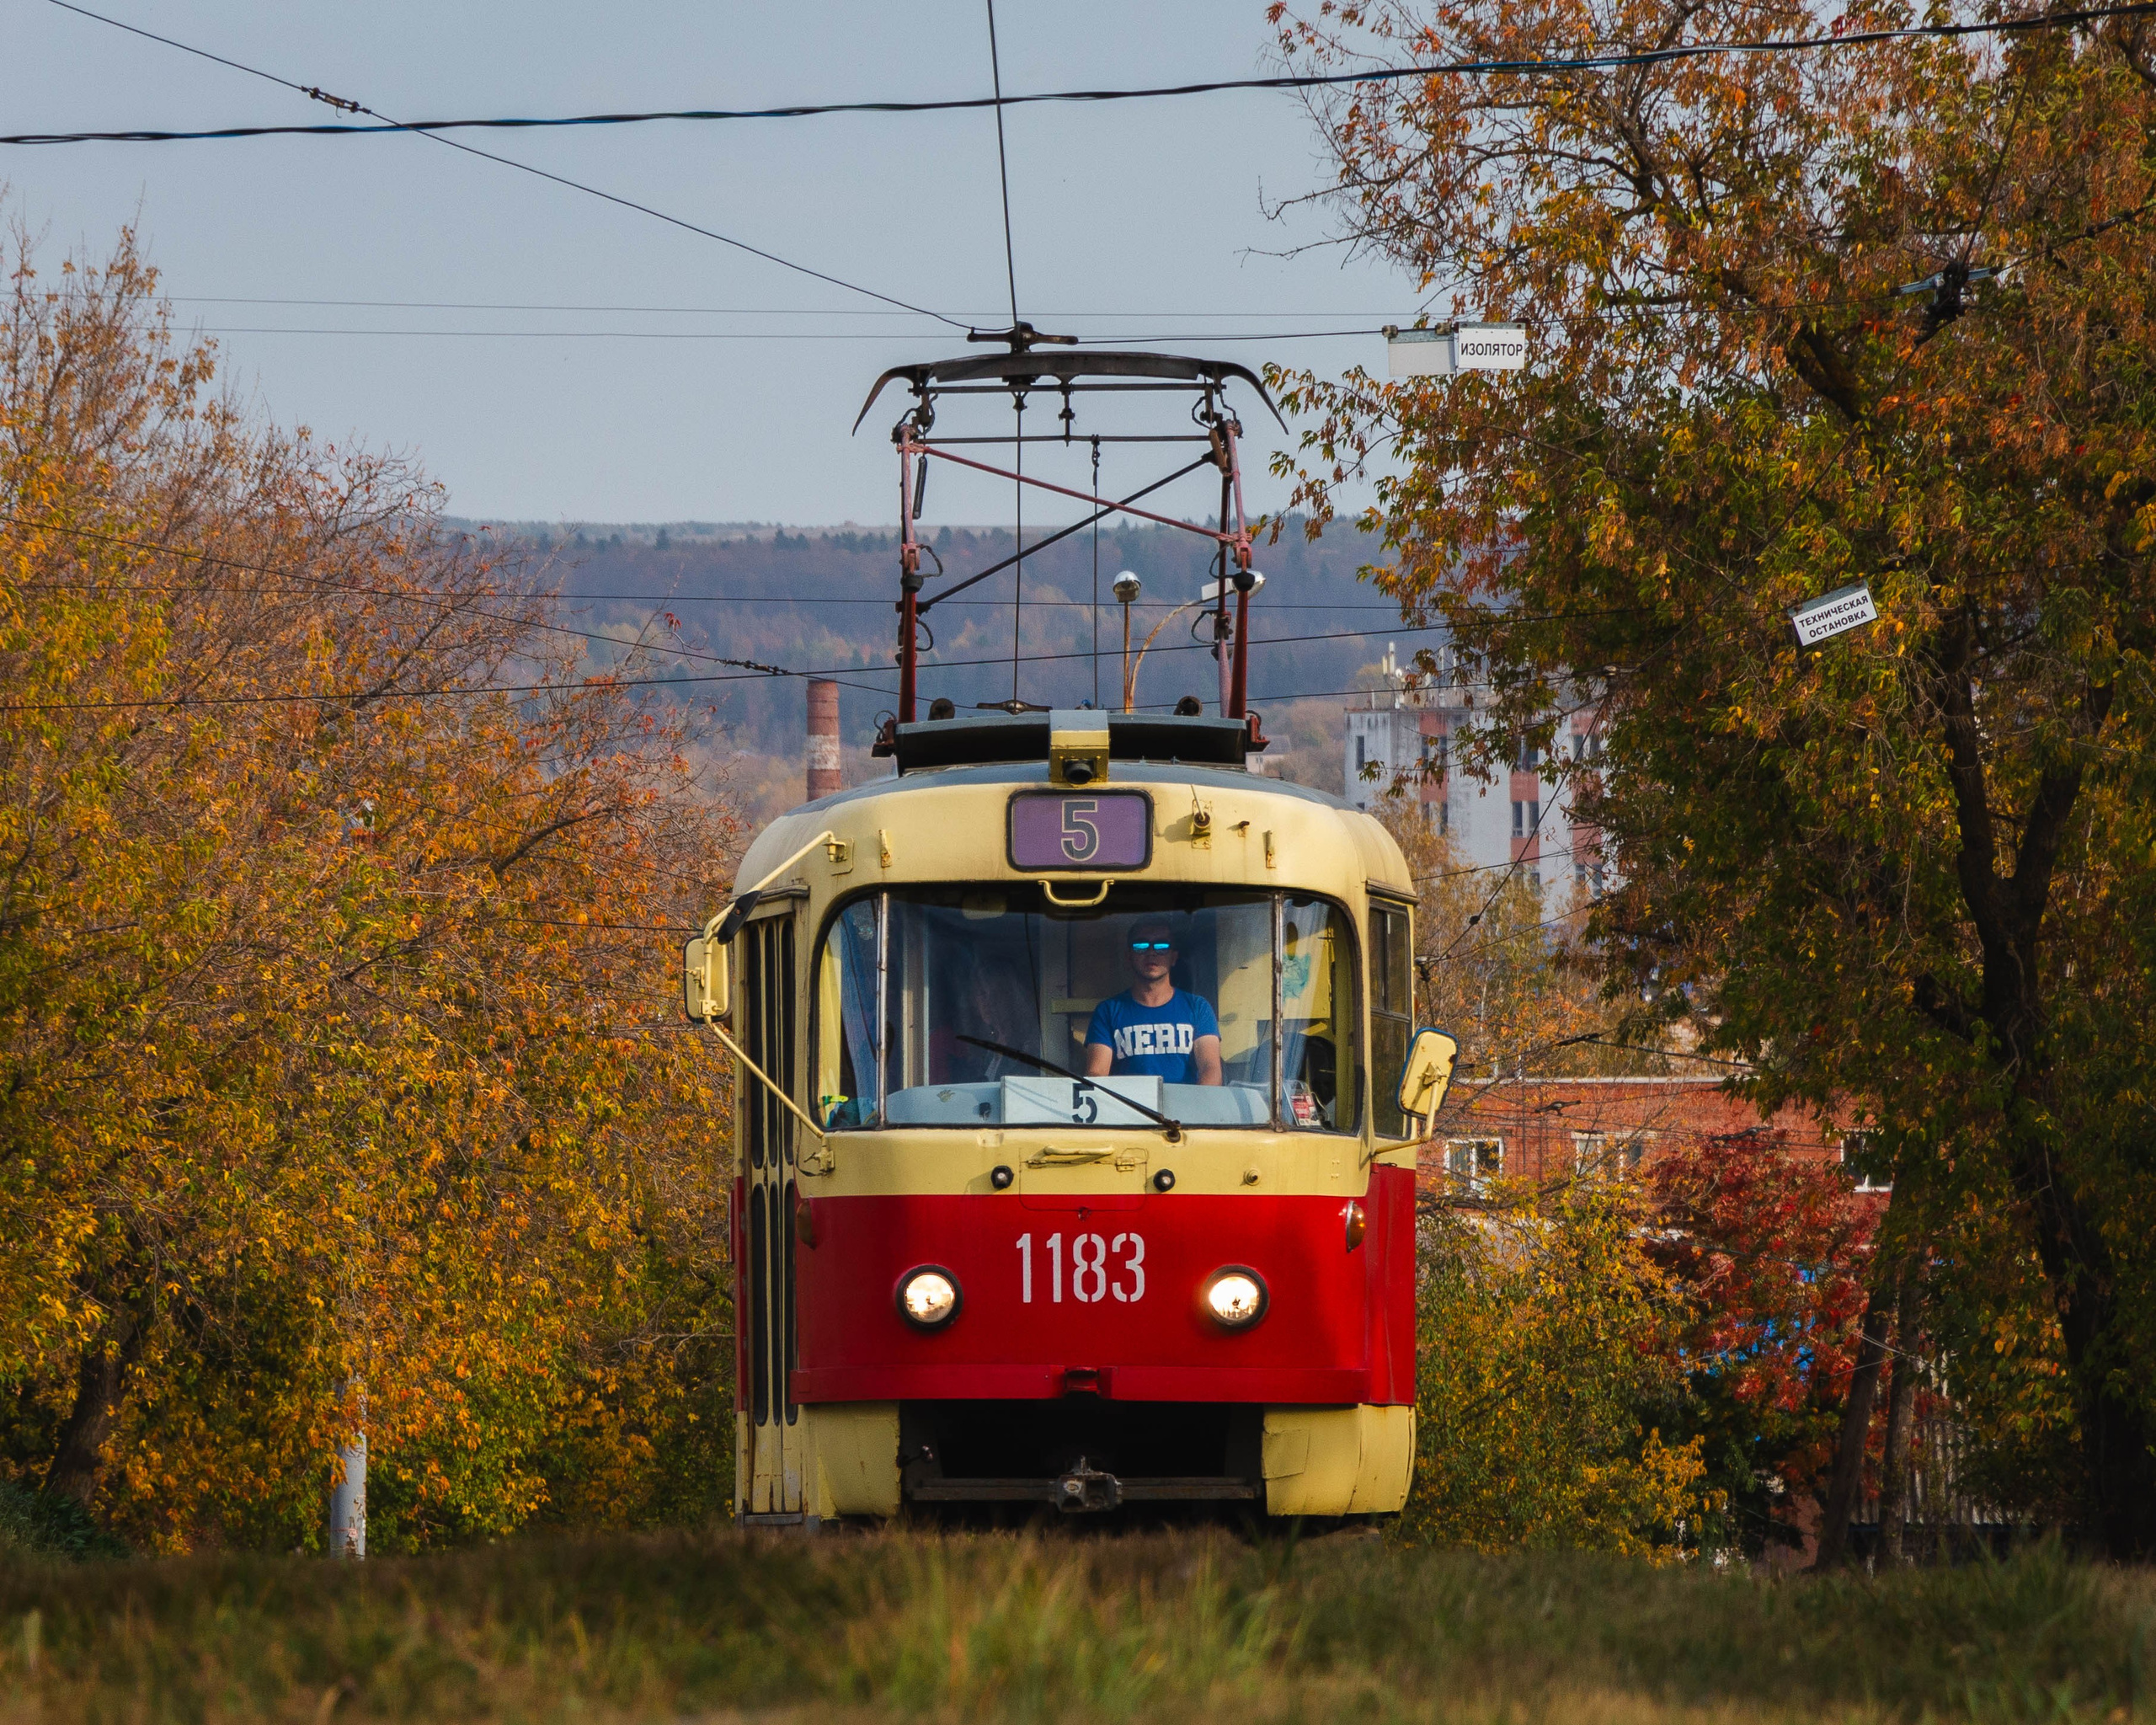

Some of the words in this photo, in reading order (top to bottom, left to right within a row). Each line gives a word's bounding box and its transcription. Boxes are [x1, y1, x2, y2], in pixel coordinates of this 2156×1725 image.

[1460, 343, 1523, 356] ИЗОЛЯТОР
[1798, 595, 1869, 628] ТЕХНИЧЕСКАЯ
[1809, 610, 1867, 638] ОСТАНОВКА
[1061, 800, 1099, 862] 5
[1113, 1023, 1194, 1060] NERD
[1072, 1082, 1098, 1124] 5
[1016, 1232, 1145, 1303] 1183
